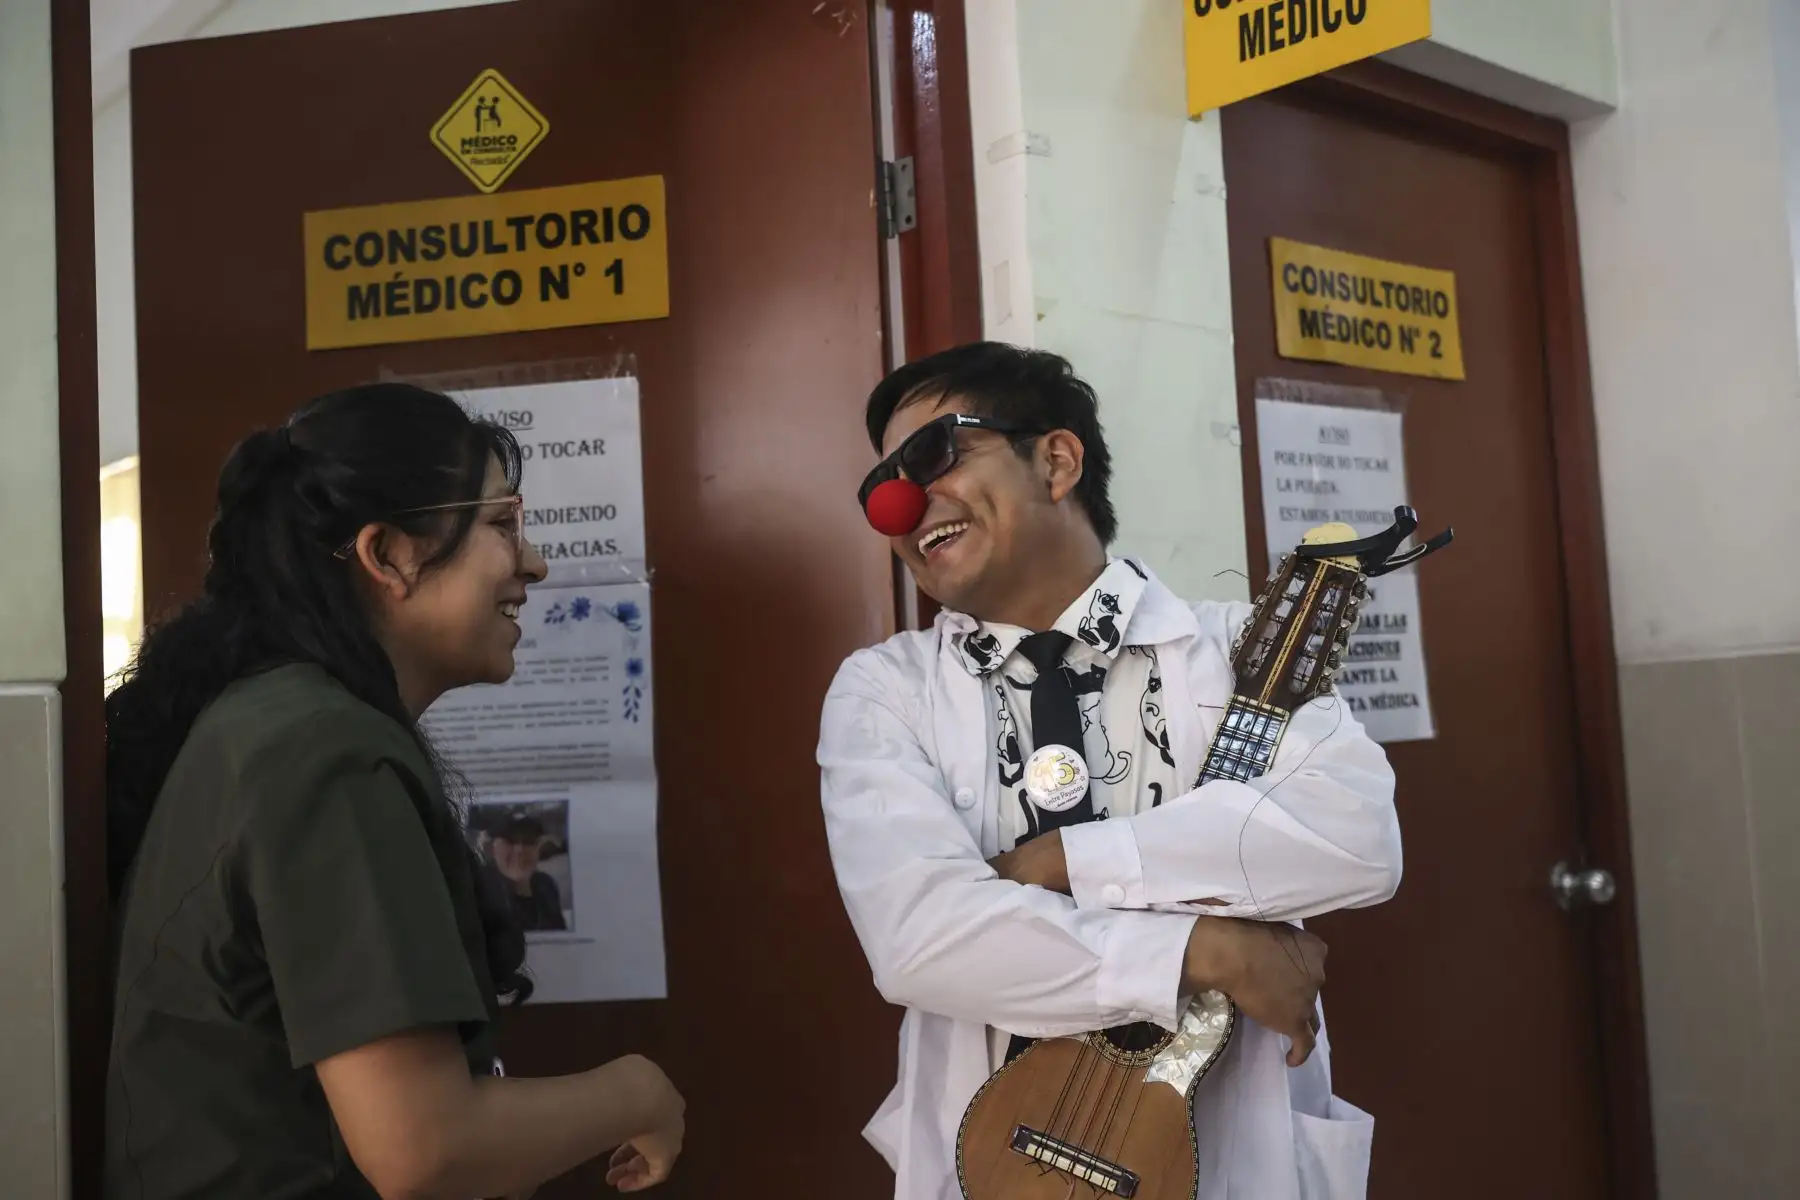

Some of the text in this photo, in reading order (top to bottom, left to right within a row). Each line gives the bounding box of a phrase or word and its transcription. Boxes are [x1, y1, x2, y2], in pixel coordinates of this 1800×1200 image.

[323, 203, 651, 271] CONSULTORIO
[346, 270, 523, 321] MÉDICO
[603, 258, 625, 296] 1
[1282, 263, 1449, 318] CONSULTORIO
[1298, 304, 1392, 351] MÉDICO
[1428, 330, 1444, 360] 2
[520, 438, 606, 461] O TOCAR
[1276, 477, 1292, 494] LA
[522, 504, 617, 527] ENDIENDO
[534, 538, 624, 561] RACIAS.
[1383, 613, 1407, 628] LAS
[1347, 641, 1401, 658] ACIONES
[1340, 667, 1399, 684] ANTE LA
[1369, 690, 1420, 710] MÉDICA
